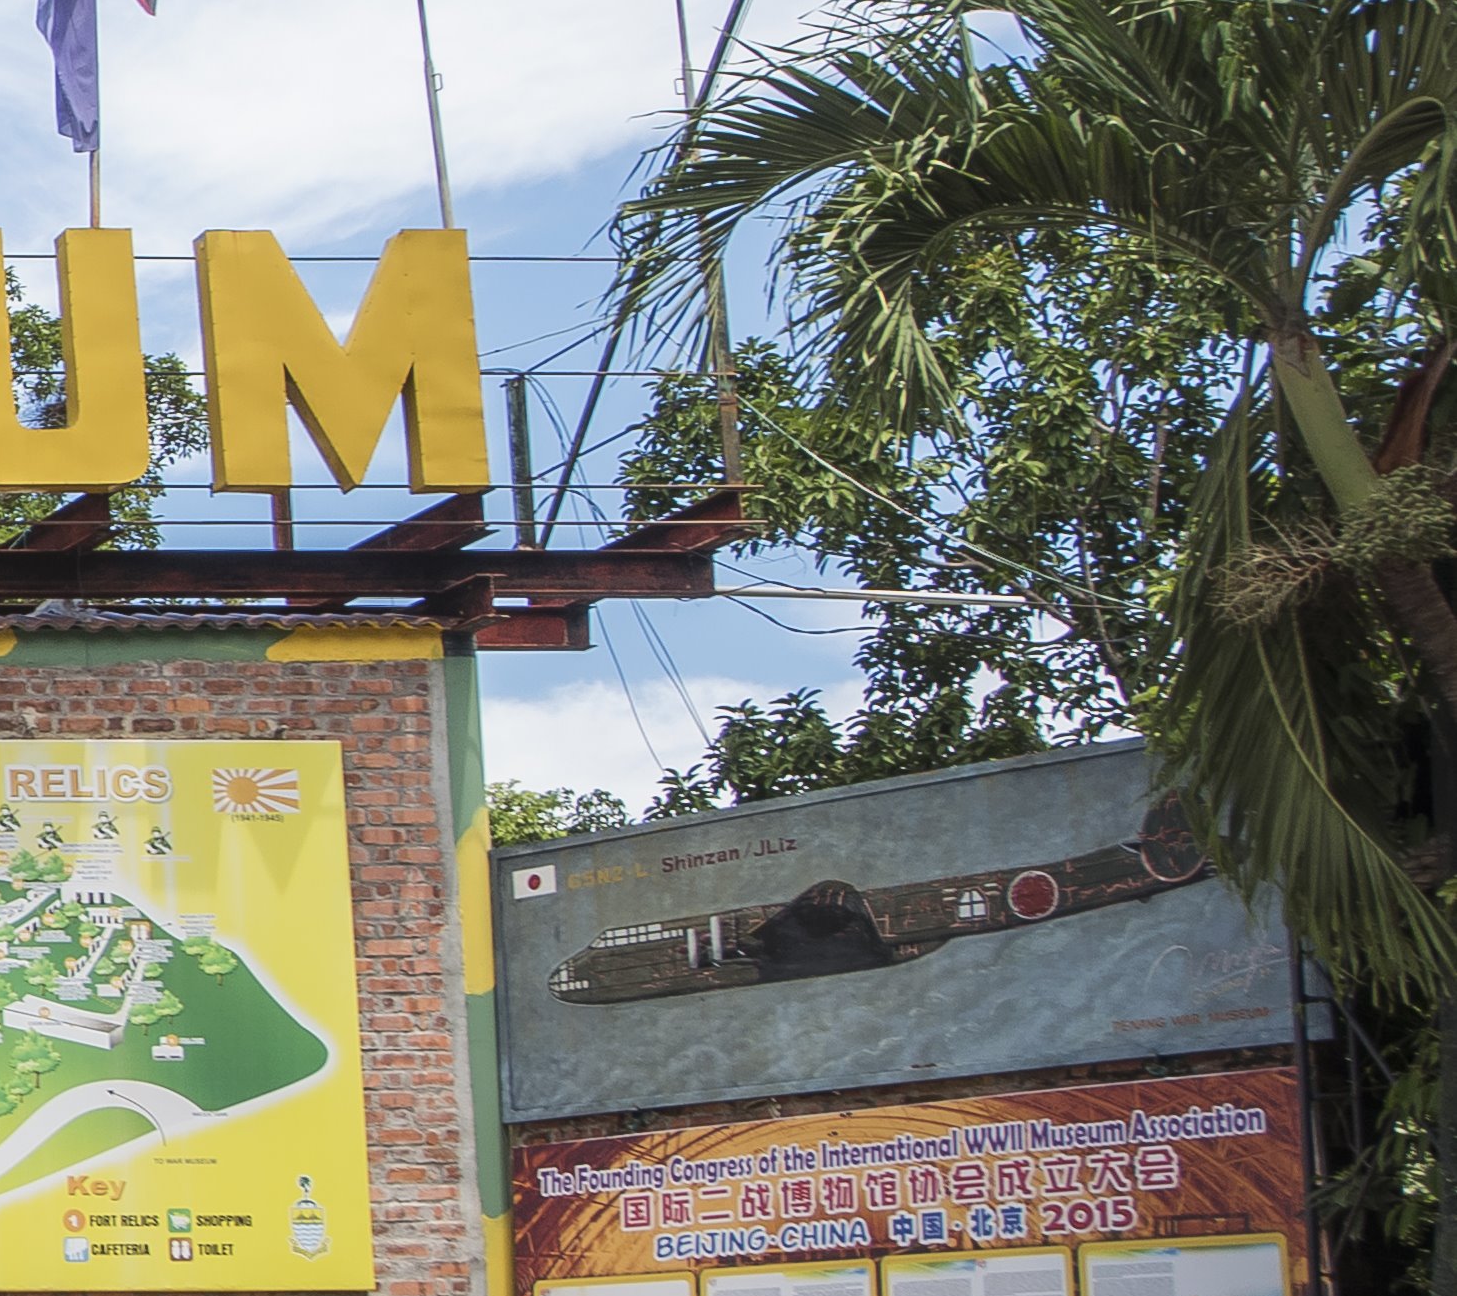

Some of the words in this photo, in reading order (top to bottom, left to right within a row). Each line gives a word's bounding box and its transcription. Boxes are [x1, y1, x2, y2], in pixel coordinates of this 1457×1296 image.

[8, 764, 173, 802] RELICS
[231, 814, 284, 823] (1941-1945)
[539, 1168, 573, 1196] The
[576, 1163, 665, 1194] Founding
[669, 1154, 753, 1186] Congress
[758, 1150, 780, 1175] of
[783, 1144, 817, 1173] the
[820, 1130, 959, 1171] International
[963, 1122, 1024, 1156] WWII
[1029, 1116, 1126, 1149] Museum
[1129, 1103, 1266, 1143] Association
[66, 1175, 127, 1201] Key
[621, 1144, 1180, 1232] 国际二战博物馆协会成立大会
[89, 1215, 117, 1227] FORT
[120, 1215, 160, 1227] RELICS
[195, 1215, 252, 1227] SHOPPING
[1041, 1198, 1137, 1235] 2015
[91, 1243, 151, 1256] CAFETERIA
[198, 1243, 234, 1256] TOILET
